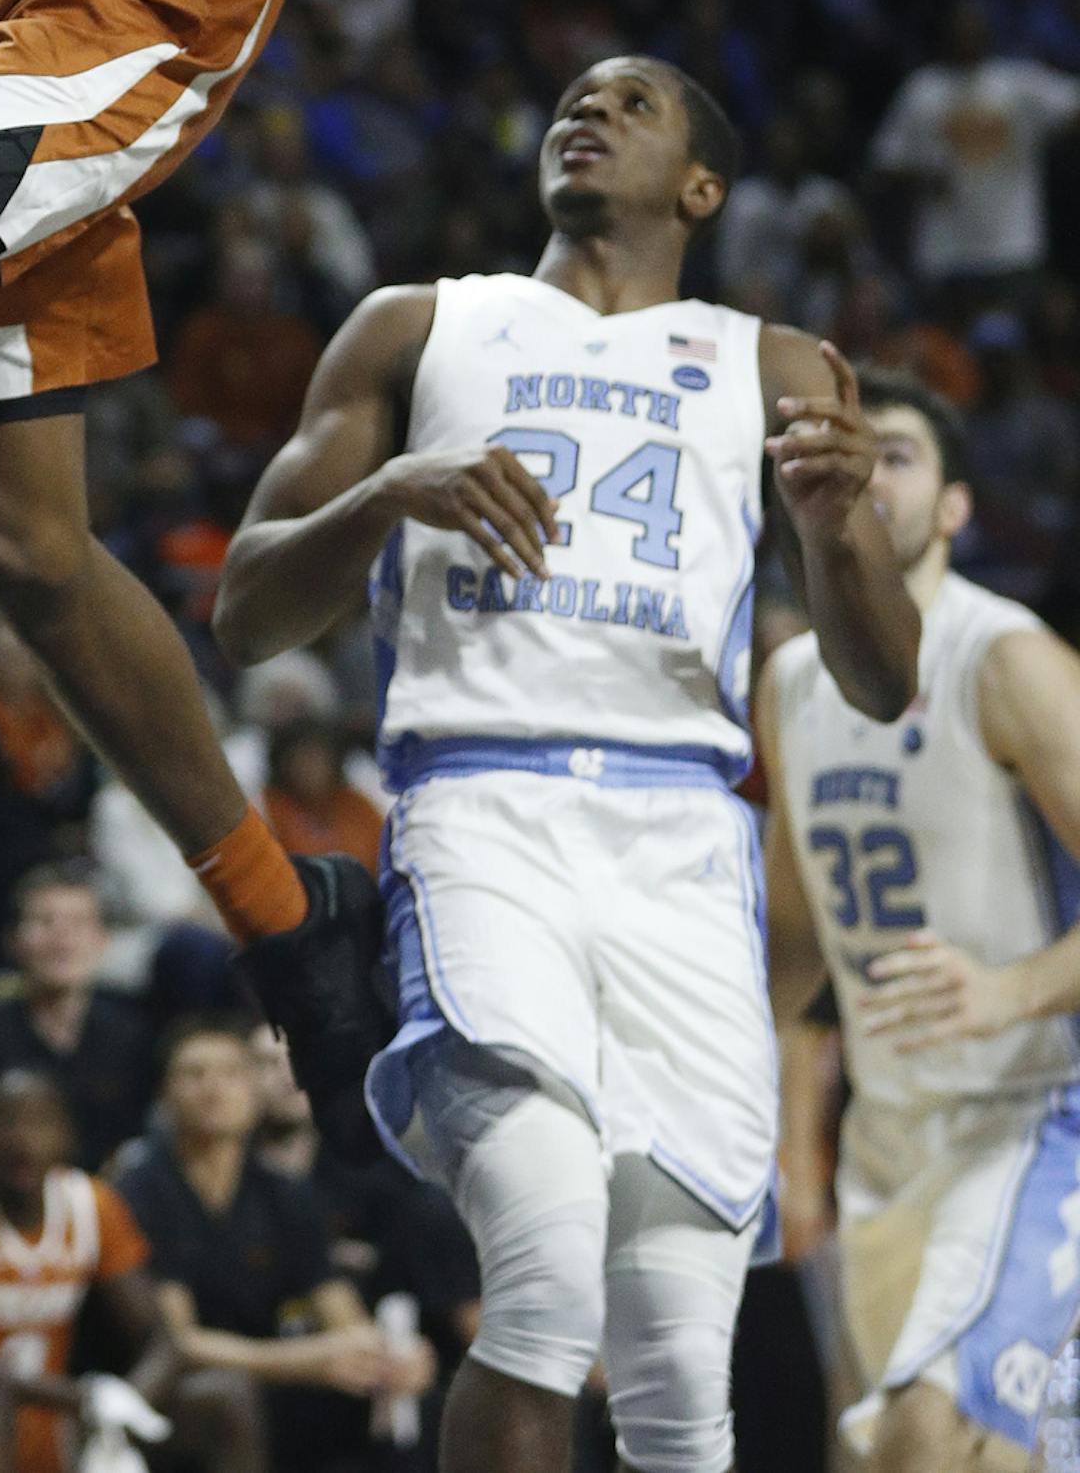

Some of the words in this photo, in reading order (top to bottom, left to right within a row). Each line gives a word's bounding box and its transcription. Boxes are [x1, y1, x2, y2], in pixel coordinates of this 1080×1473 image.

[504, 373, 681, 431] NORTH
[446, 563, 689, 640] CAROLINA
[809, 825, 925, 929] 32
